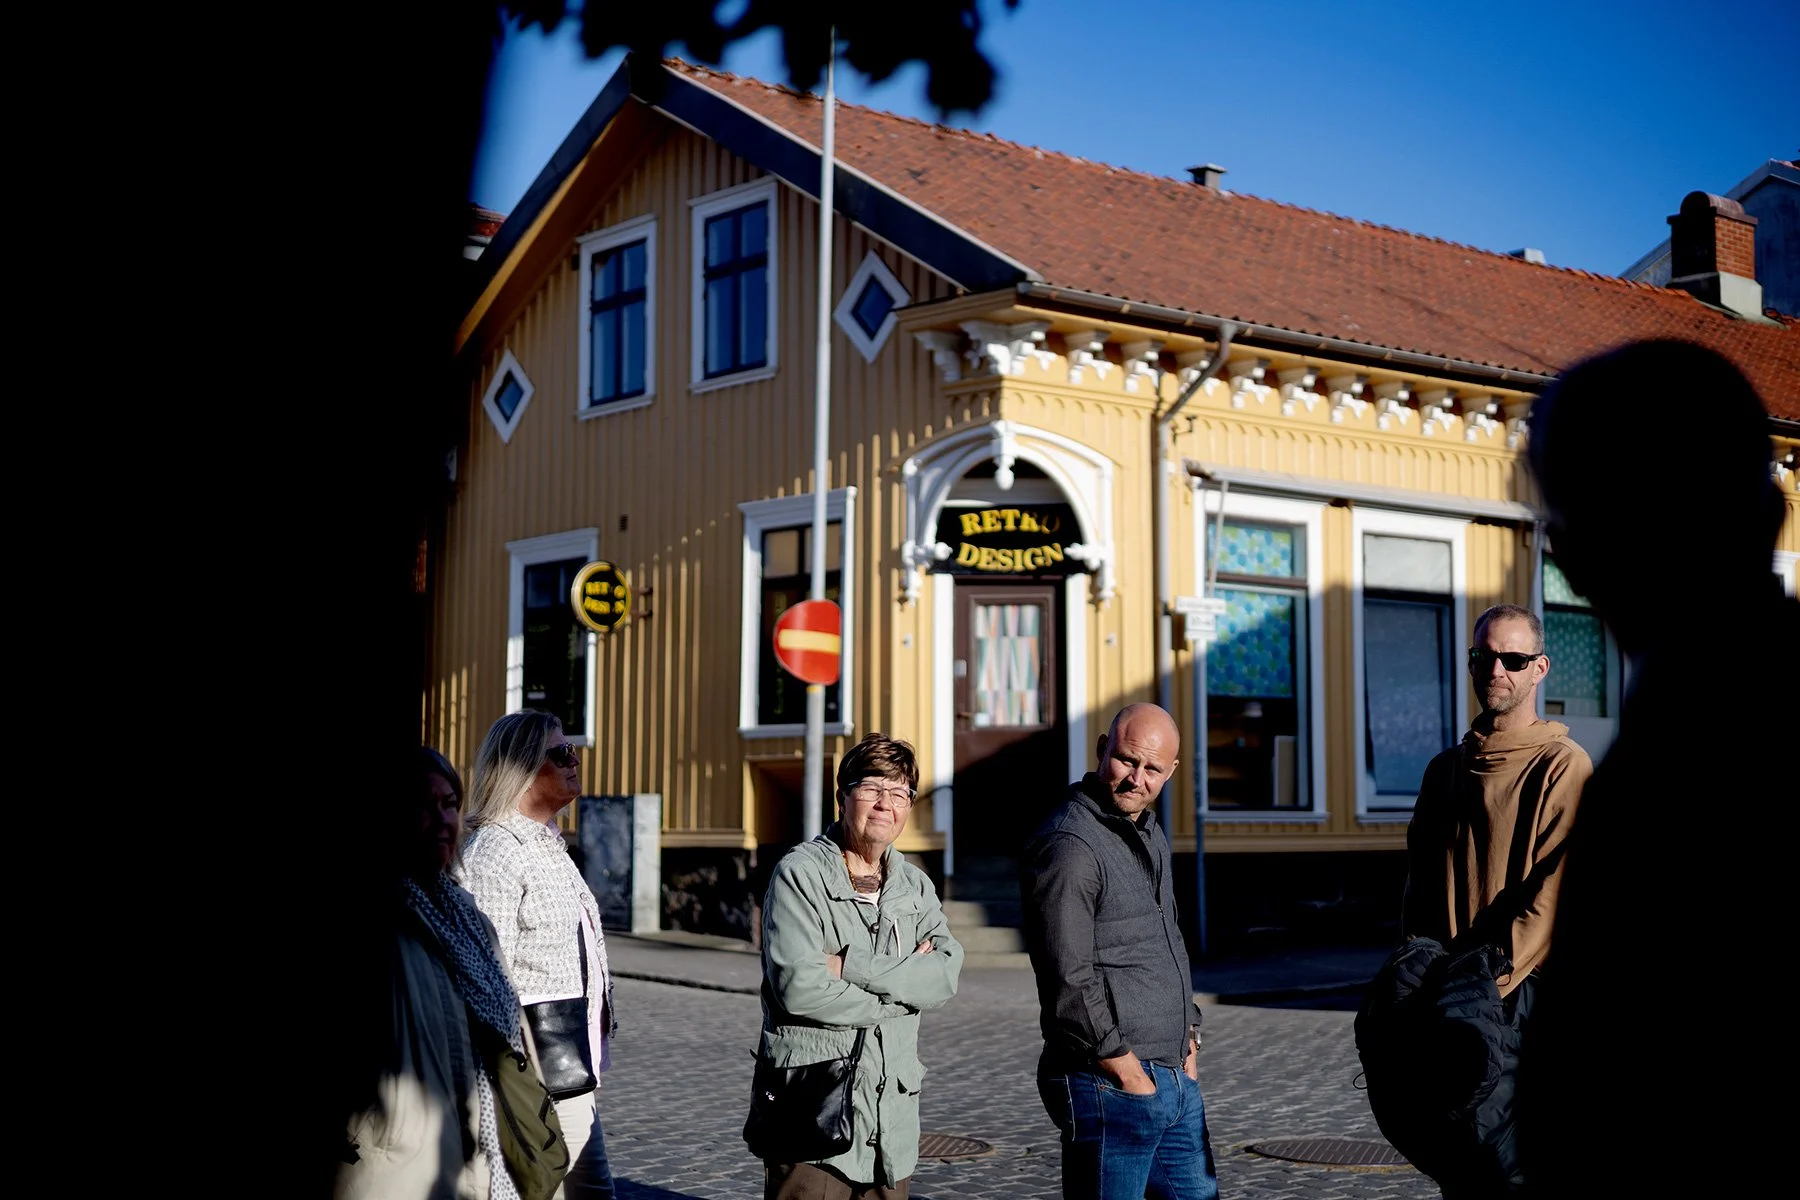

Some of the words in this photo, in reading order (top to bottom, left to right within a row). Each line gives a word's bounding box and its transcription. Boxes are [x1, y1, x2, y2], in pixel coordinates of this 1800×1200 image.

[956, 542, 1063, 572] DESIGN
[585, 581, 625, 599] RETO
[584, 596, 625, 614] DESIN
